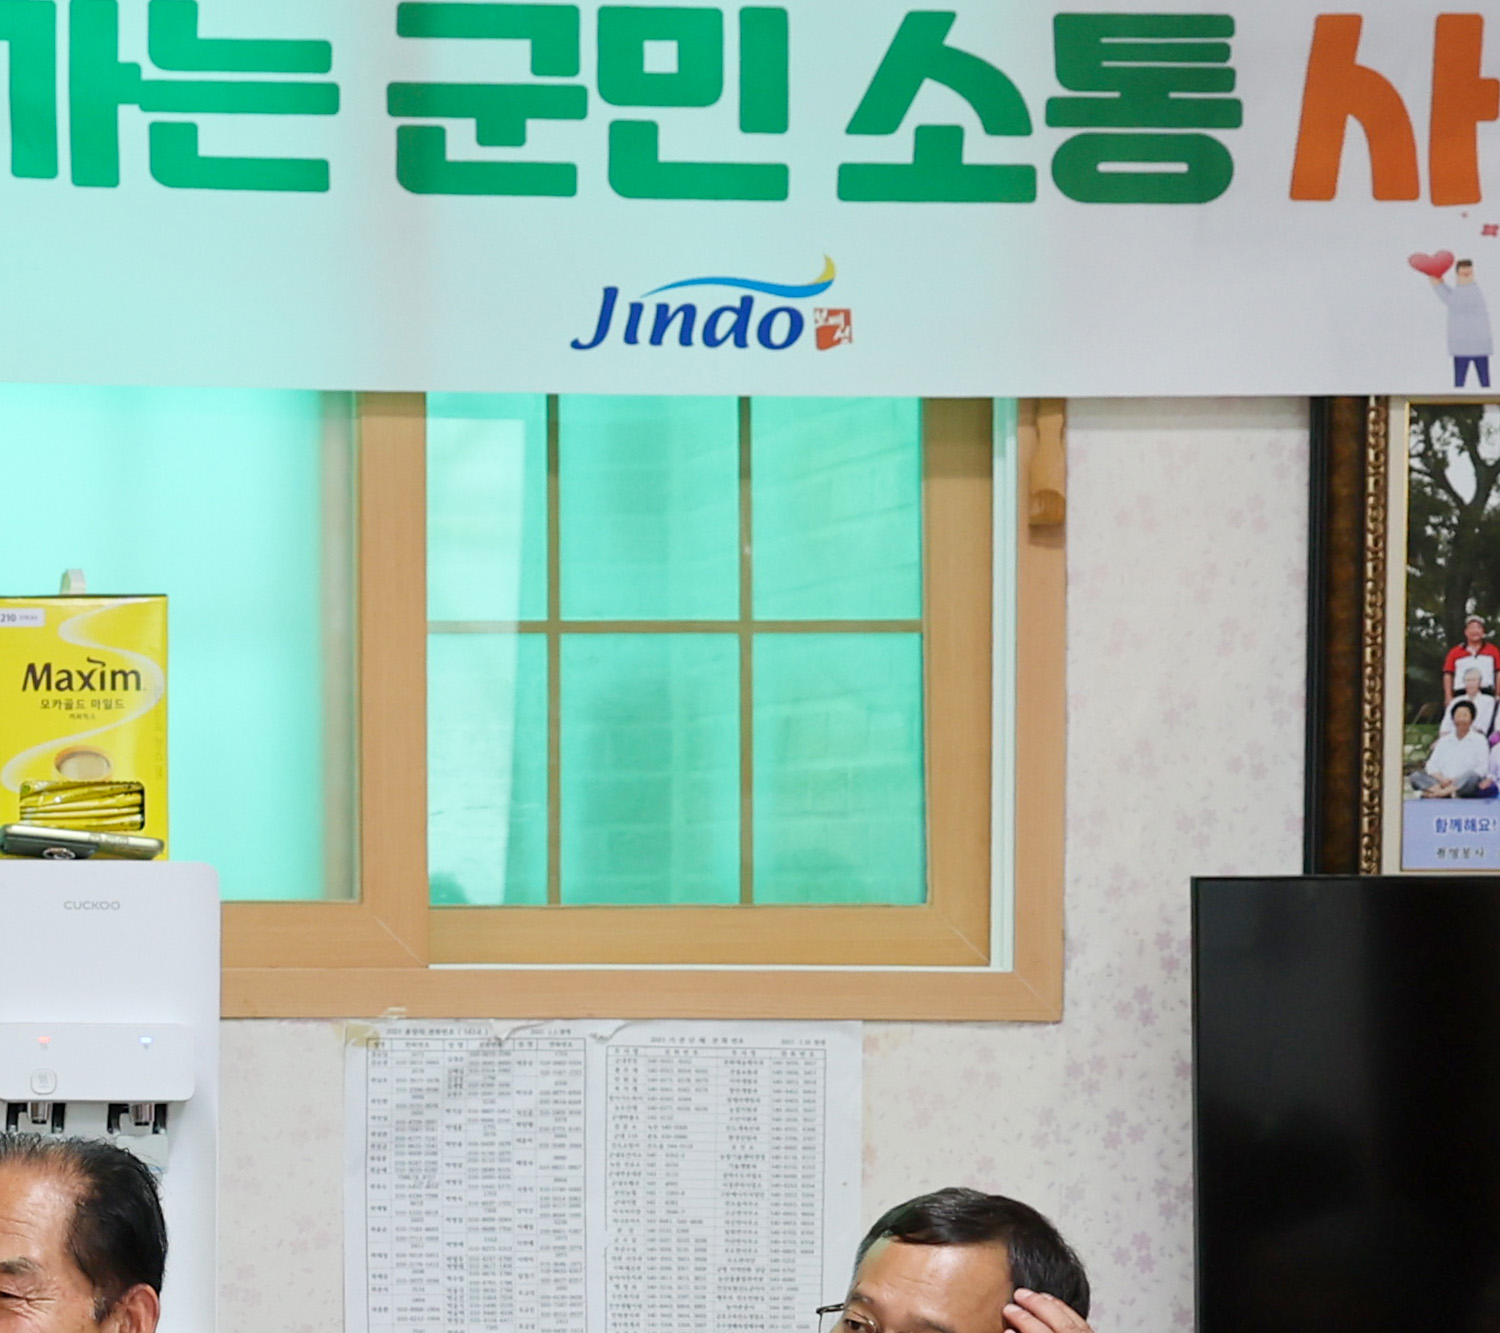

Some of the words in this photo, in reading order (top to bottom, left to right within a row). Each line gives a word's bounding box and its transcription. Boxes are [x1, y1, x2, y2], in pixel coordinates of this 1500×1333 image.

[387, 0, 789, 201] 군민
[837, 10, 1243, 204] 소통
[571, 278, 804, 352] Jindo
[22, 657, 142, 692] Maxim
[63, 900, 121, 911] CUCKOO
